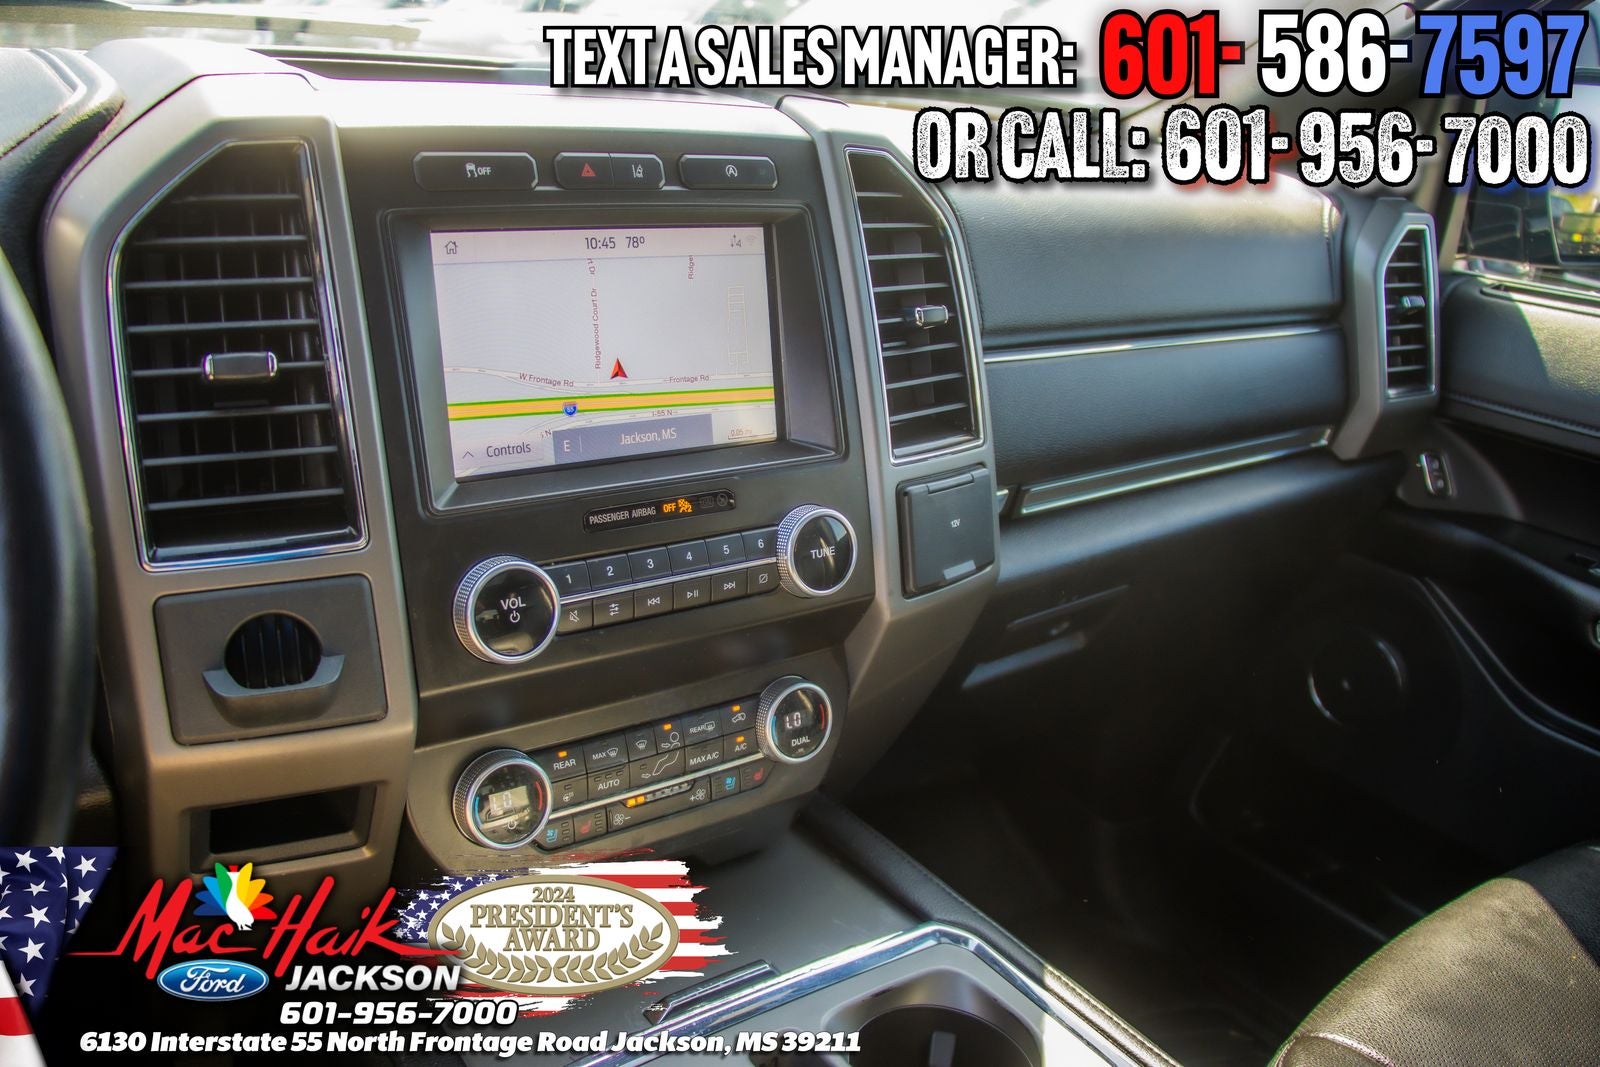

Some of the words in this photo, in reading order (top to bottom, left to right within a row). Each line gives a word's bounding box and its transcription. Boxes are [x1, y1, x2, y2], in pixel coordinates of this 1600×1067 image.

[477, 166, 492, 177] OFF
[585, 236, 616, 250] 10:45
[592, 323, 601, 369] Ridgewood
[529, 374, 562, 387] Frontage
[669, 376, 699, 384] Frontage
[563, 439, 571, 453] E
[619, 431, 661, 447] Jackson,
[661, 427, 678, 441] MS
[486, 441, 532, 459] Controls
[588, 509, 630, 526] PASSENGER
[631, 506, 657, 518] AIRBAG
[662, 503, 677, 514] OFF
[722, 544, 731, 556] 5
[757, 538, 766, 550] 6
[685, 551, 694, 563] 4
[809, 545, 837, 562] TUNE
[646, 558, 655, 570] 3
[606, 565, 615, 577] 2
[565, 574, 573, 585] 1
[500, 596, 527, 611] VOL
[689, 724, 707, 735] REAR
[791, 735, 811, 748] DUAL
[734, 744, 749, 753] A/C
[592, 750, 608, 761] MAX
[689, 754, 706, 767] MAX
[703, 751, 721, 763] A/C
[553, 758, 577, 771] REAR
[597, 778, 621, 792] AUTO
